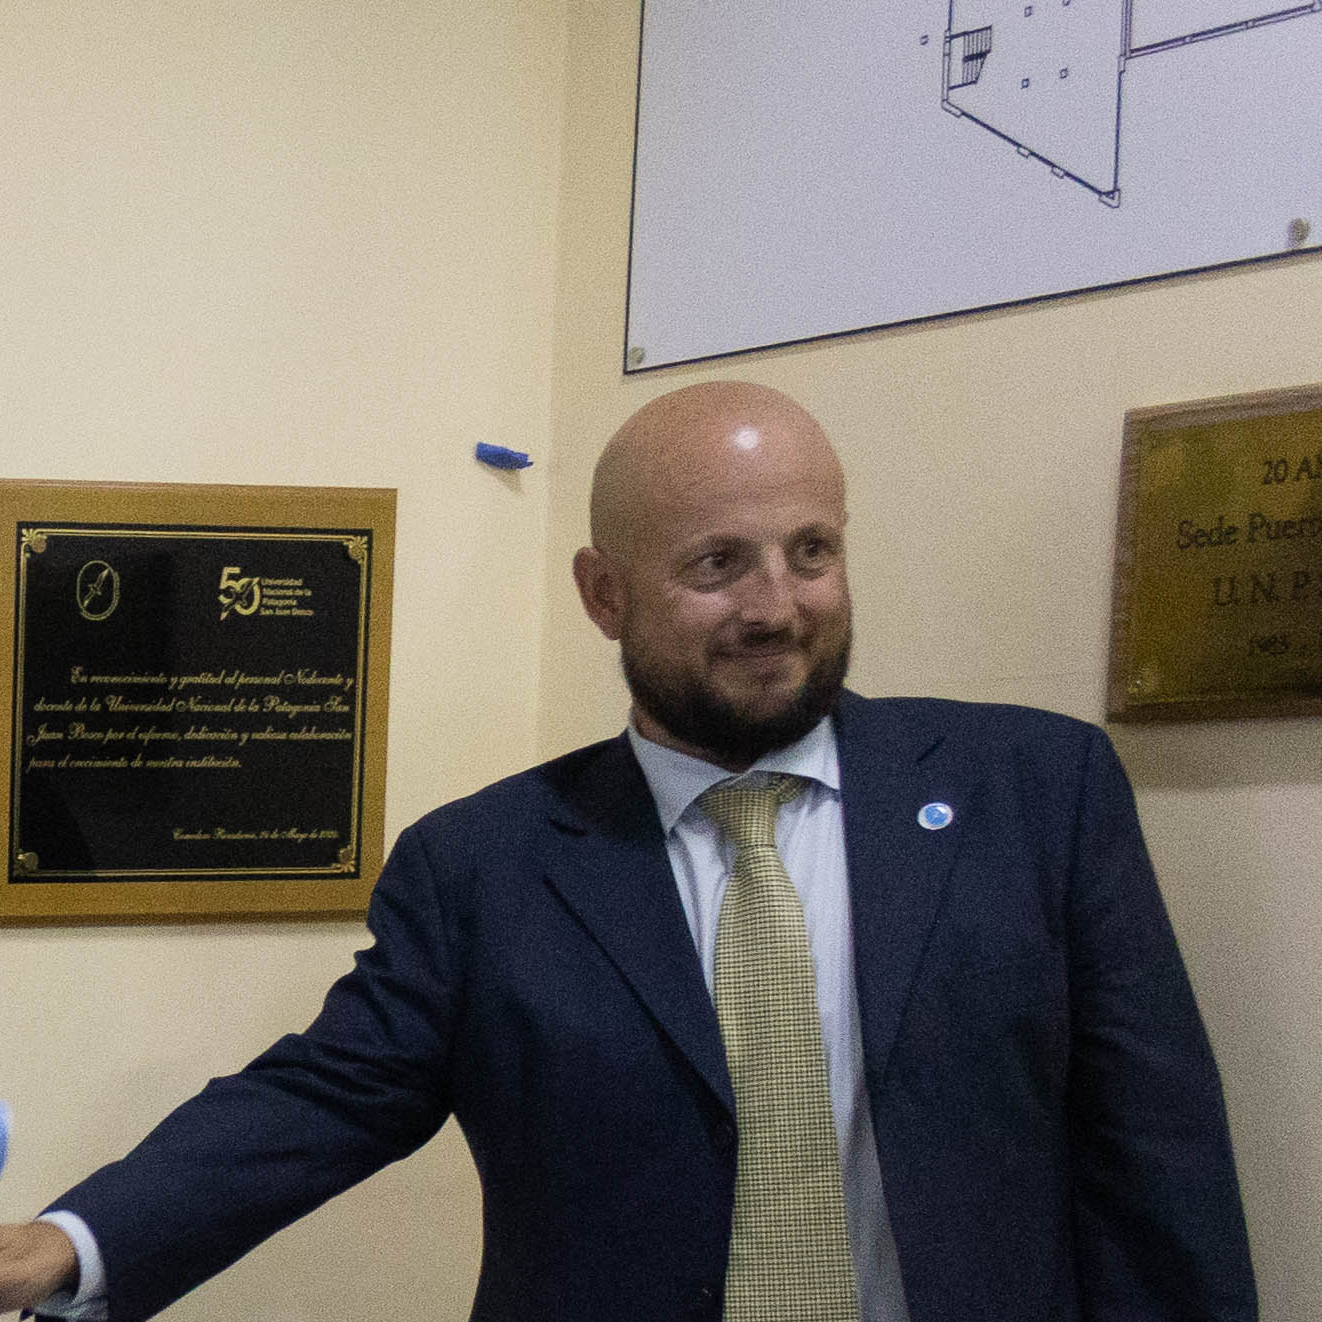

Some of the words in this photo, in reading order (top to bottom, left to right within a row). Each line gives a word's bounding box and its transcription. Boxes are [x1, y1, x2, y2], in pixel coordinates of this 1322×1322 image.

[1176, 514, 1240, 550] Sede
[70, 665, 88, 684] En
[235, 669, 286, 690] personal
[33, 696, 74, 712] docente
[74, 697, 88, 712] de
[89, 697, 102, 712] la
[106, 694, 176, 712] Universidad
[176, 696, 236, 713] Nacional
[234, 698, 247, 712] de
[247, 698, 260, 712] la
[263, 695, 321, 719] Patagonia
[323, 695, 350, 712] San
[26, 722, 64, 747] Juan
[67, 722, 106, 741] Bosco
[103, 727, 126, 744] por
[125, 725, 140, 740] el
[129, 751, 143, 769] de
